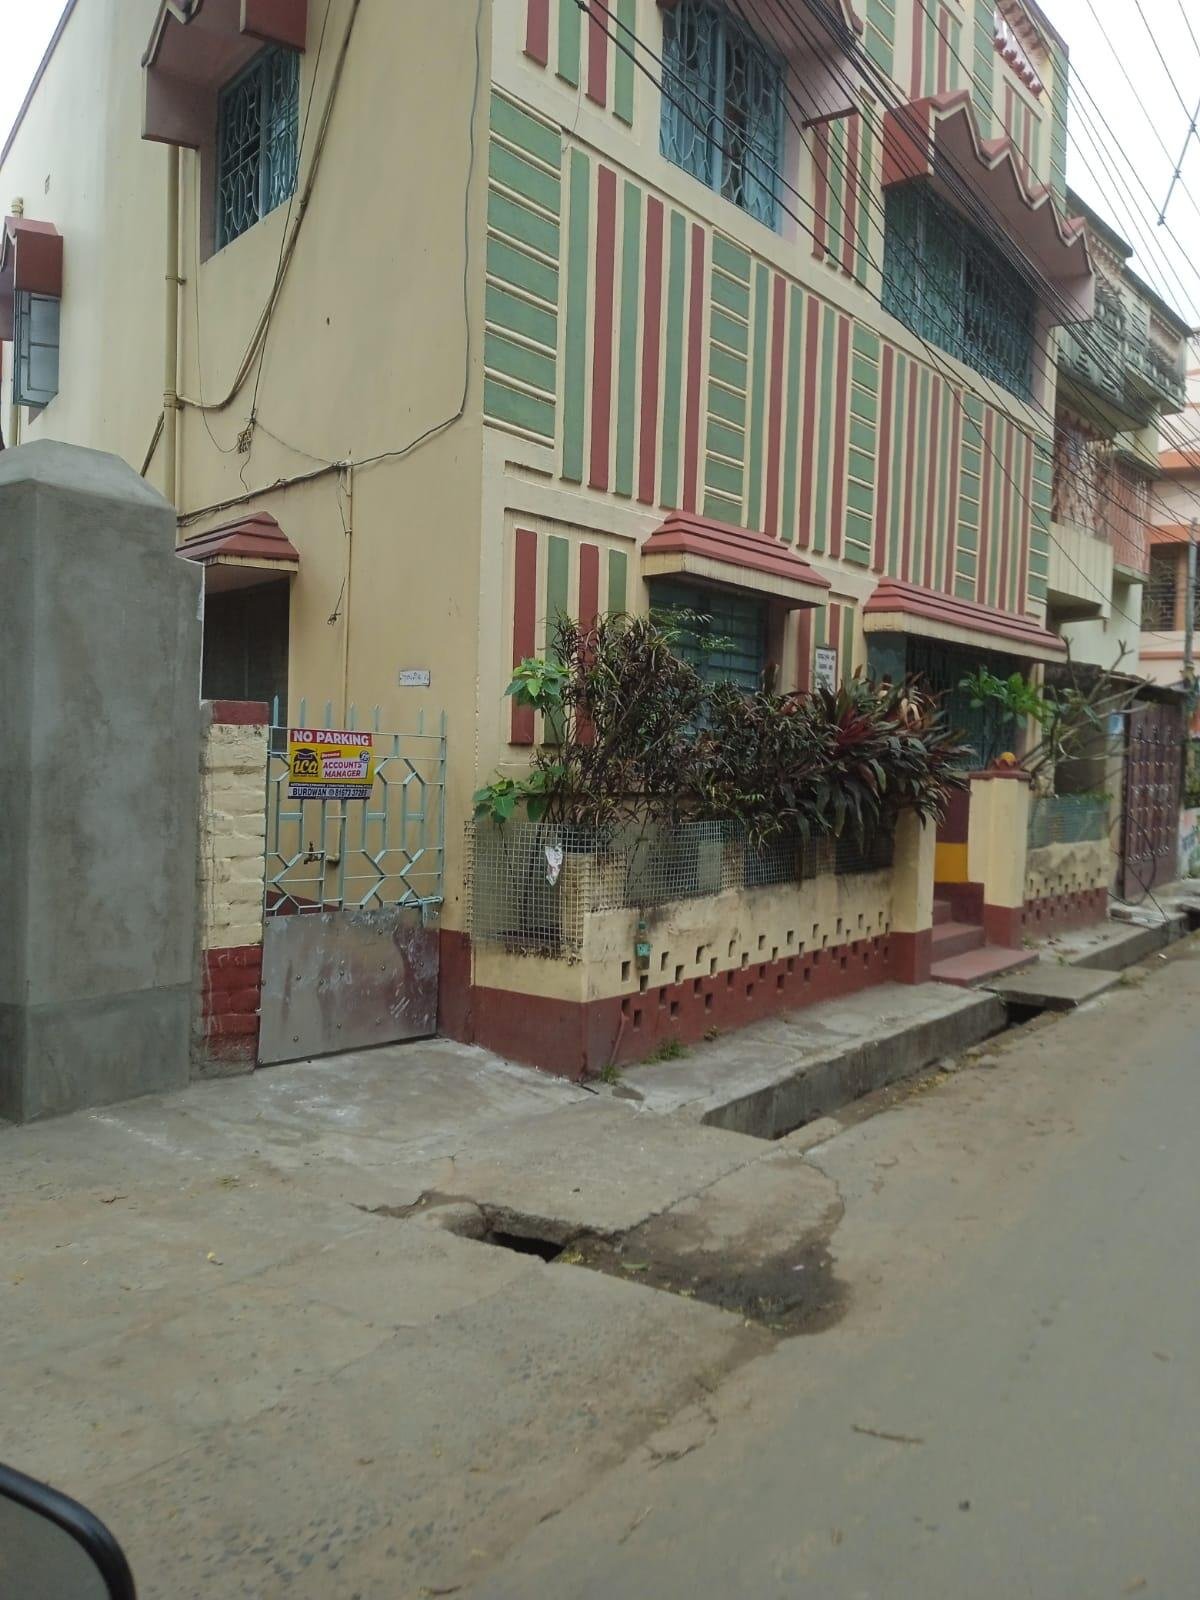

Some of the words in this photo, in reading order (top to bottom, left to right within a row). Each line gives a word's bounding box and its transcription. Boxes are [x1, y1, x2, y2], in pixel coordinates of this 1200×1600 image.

[293, 730, 313, 742] NO
[316, 732, 369, 746] PARKING
[323, 761, 362, 769] ACCOUNTS
[324, 770, 361, 778] MANAGER
[292, 787, 327, 797] BURDWAN
